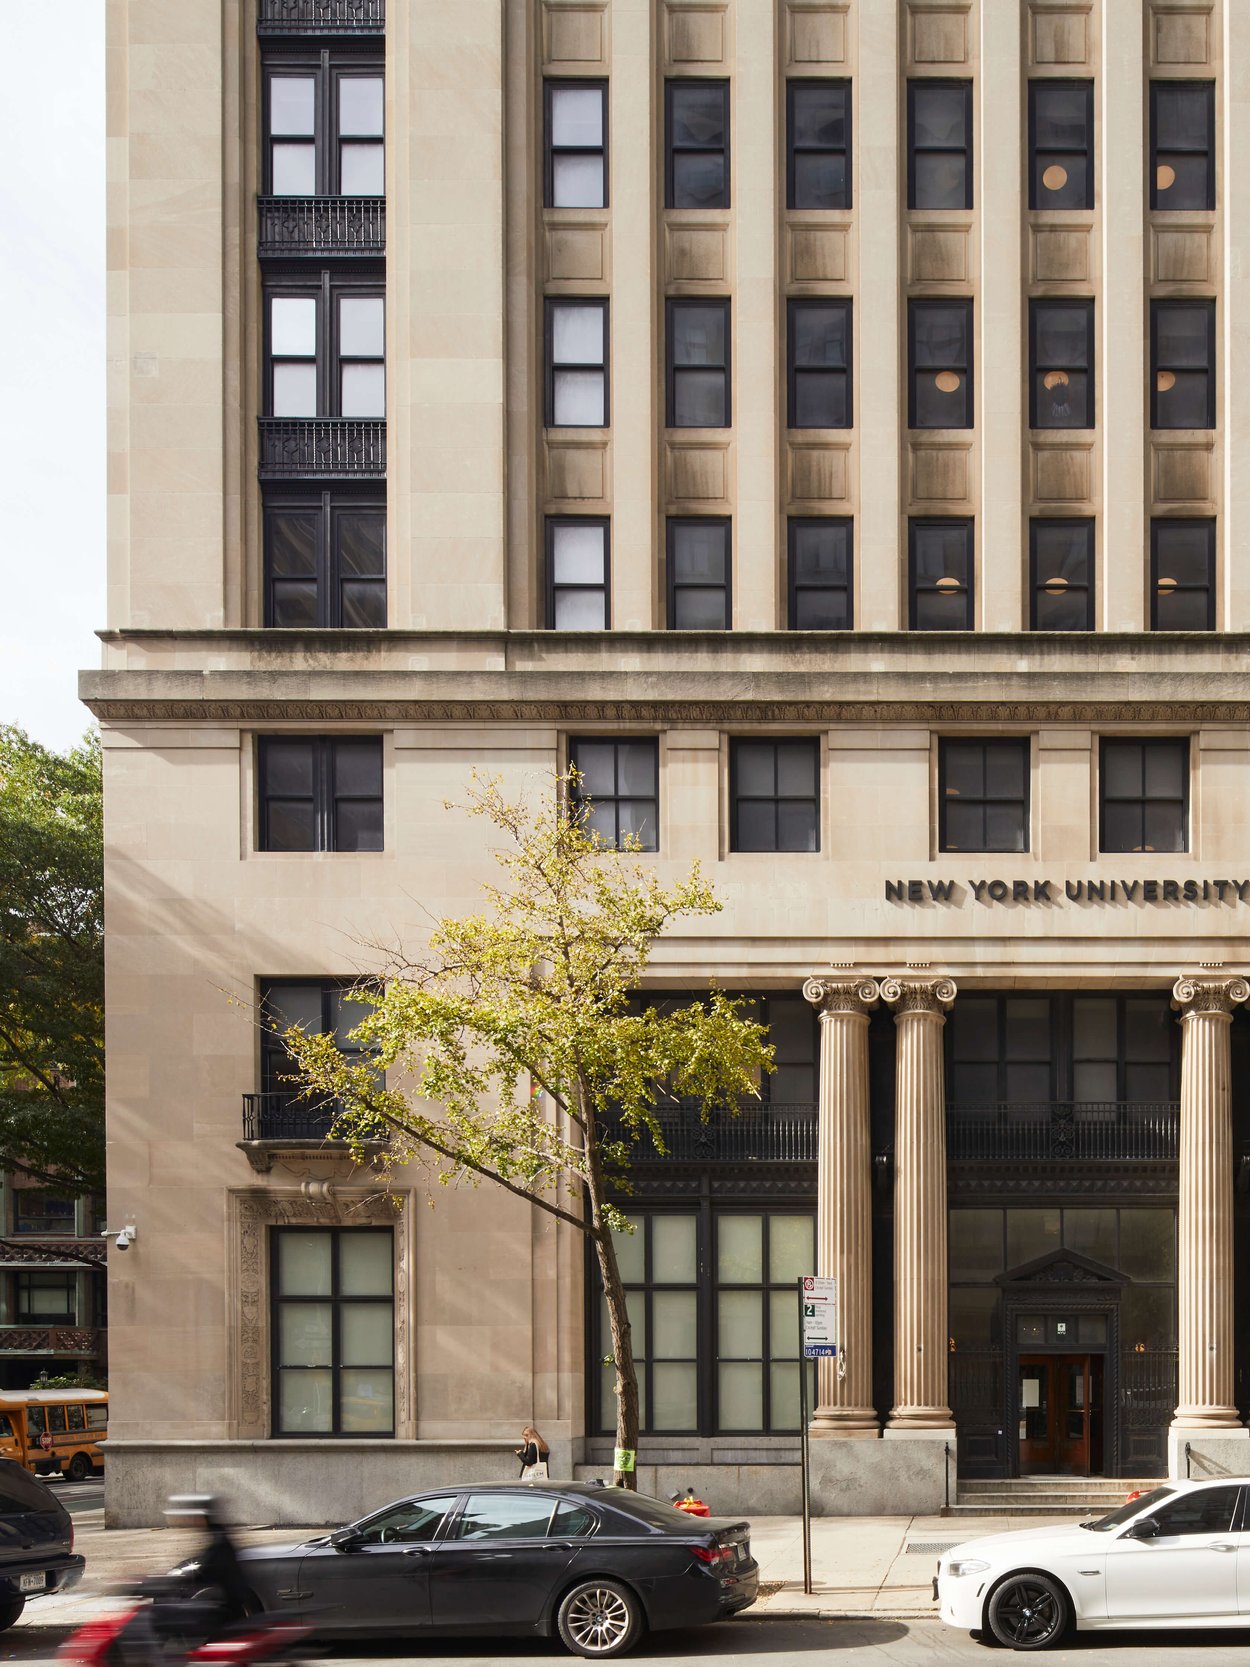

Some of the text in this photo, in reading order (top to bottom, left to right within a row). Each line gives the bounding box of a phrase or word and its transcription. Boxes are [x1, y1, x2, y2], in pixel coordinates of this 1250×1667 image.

[885, 879, 1250, 901] NEW YORK UNIVERSITY
[806, 1304, 812, 1315] 2
